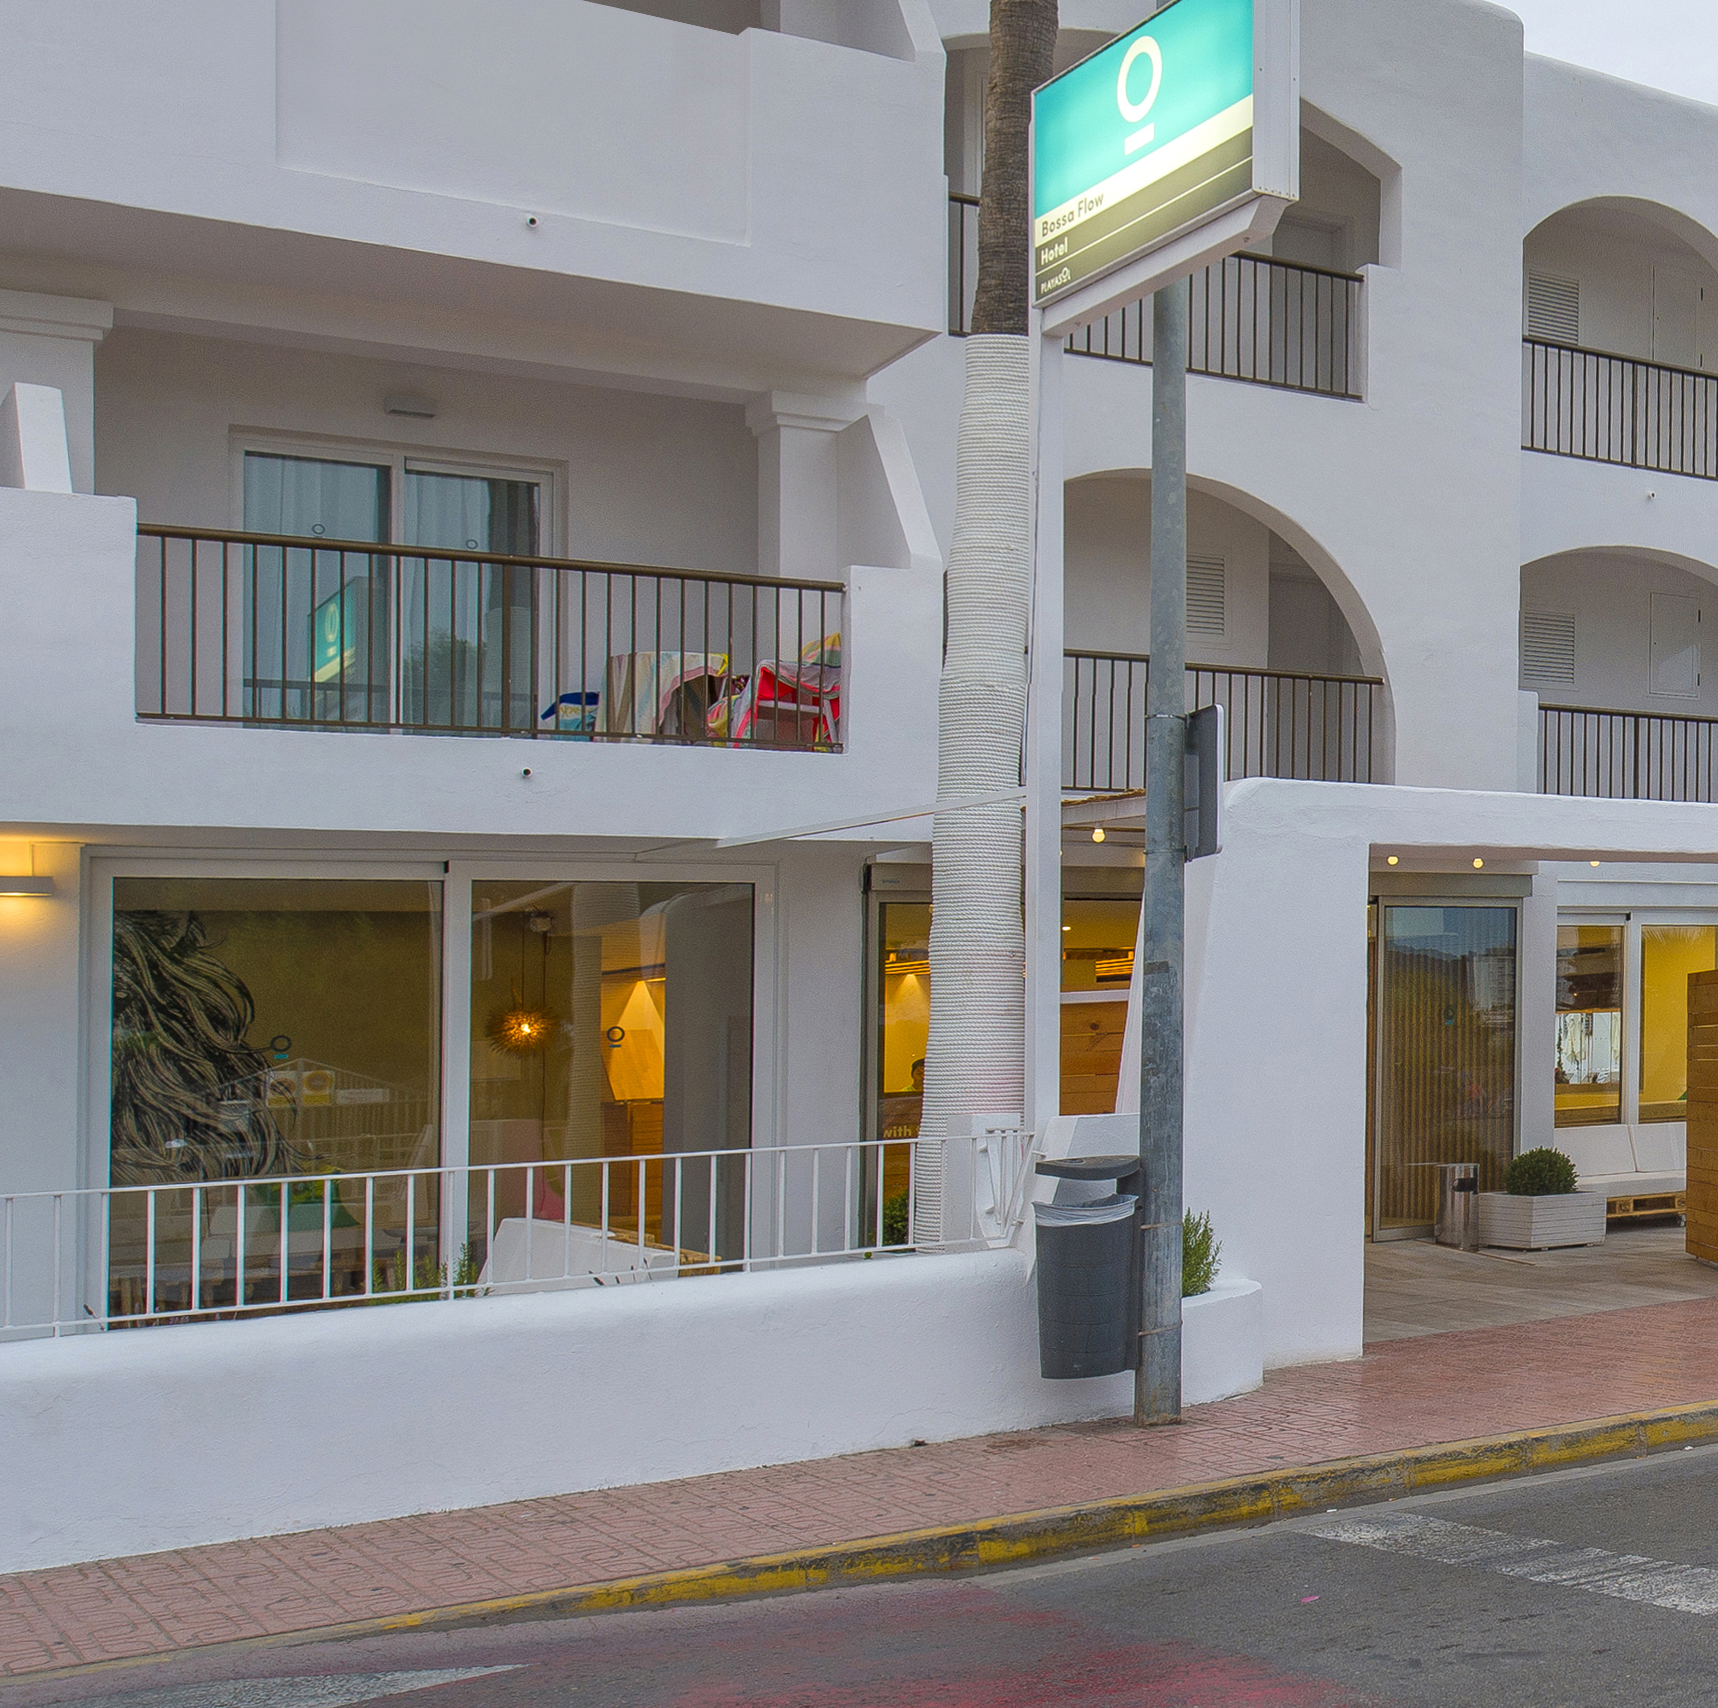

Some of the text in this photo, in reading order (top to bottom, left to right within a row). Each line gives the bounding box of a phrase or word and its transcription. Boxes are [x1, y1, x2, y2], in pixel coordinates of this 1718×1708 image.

[1042, 193, 1104, 237] Bossa Flow
[1041, 236, 1068, 266] Hotel
[1041, 267, 1071, 294] PLAYASOL
[883, 1125, 912, 1138] with
